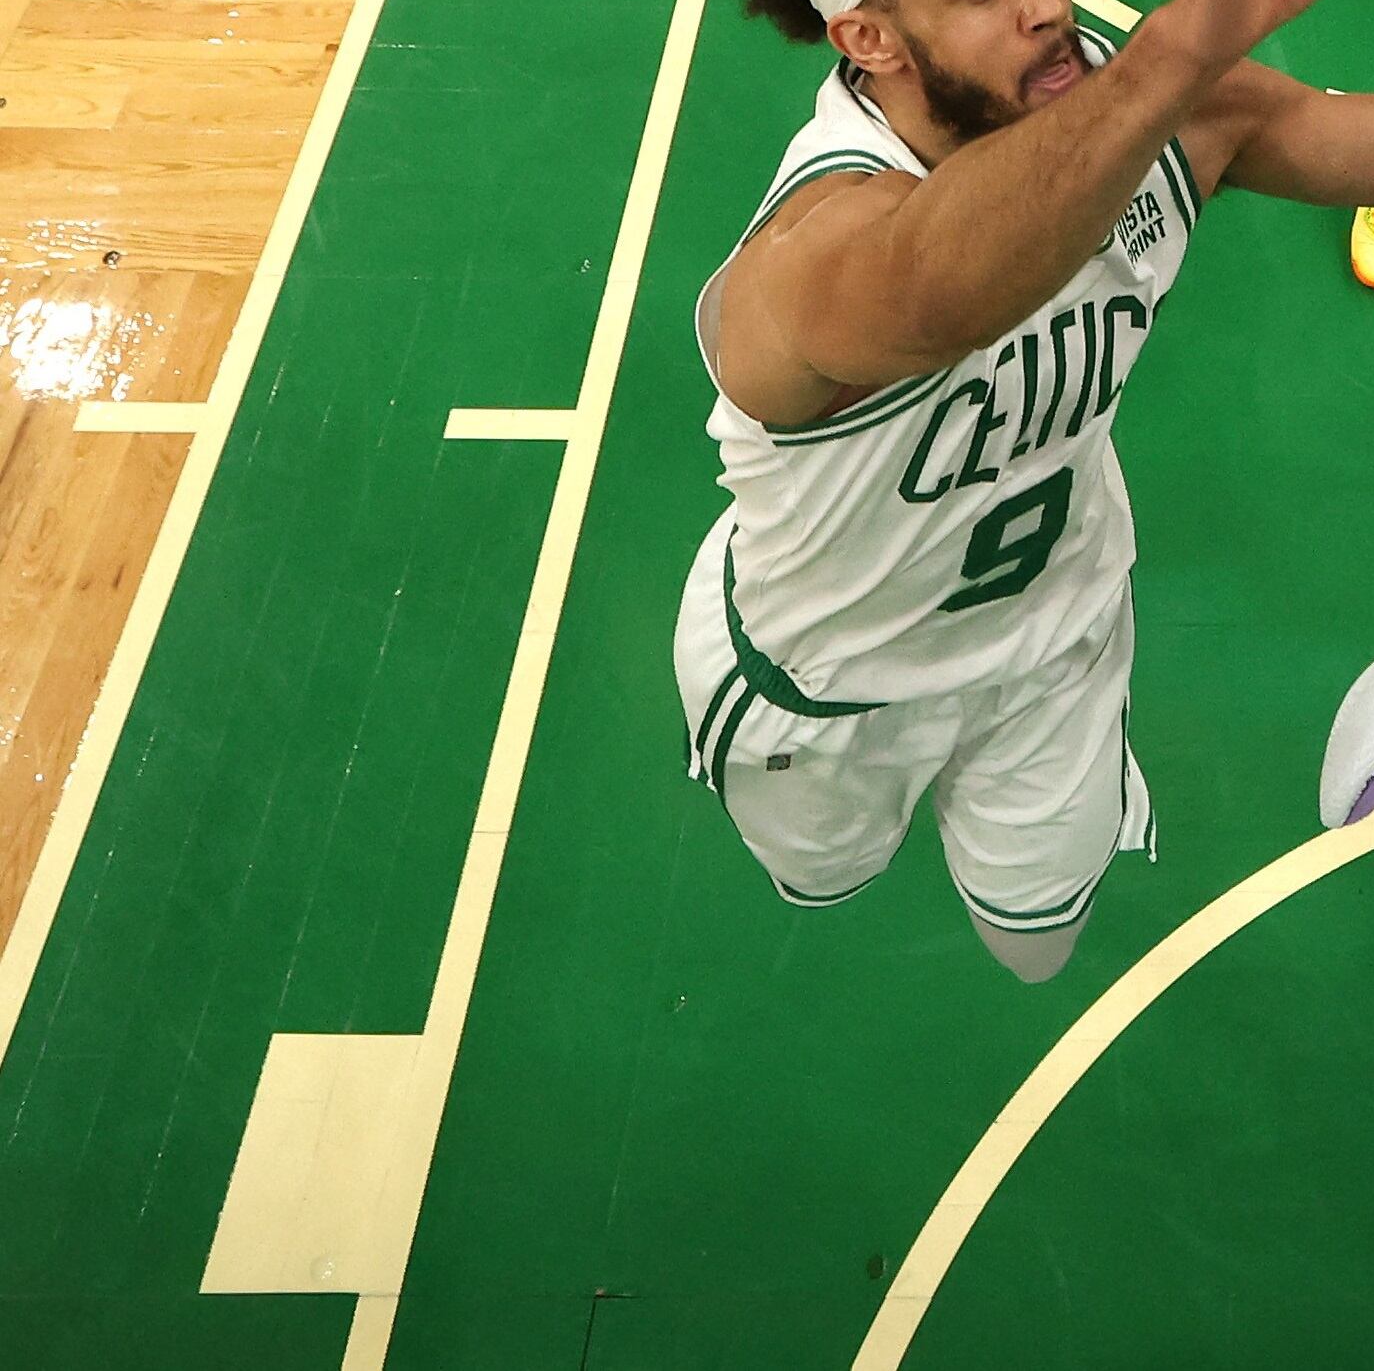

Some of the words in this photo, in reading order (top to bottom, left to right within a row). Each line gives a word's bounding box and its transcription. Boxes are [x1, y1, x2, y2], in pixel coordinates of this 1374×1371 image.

[1115, 190, 1163, 249] VISTA
[1127, 216, 1167, 270] PRINT
[898, 293, 1166, 504] CELTIC
[937, 465, 1075, 613] 9
